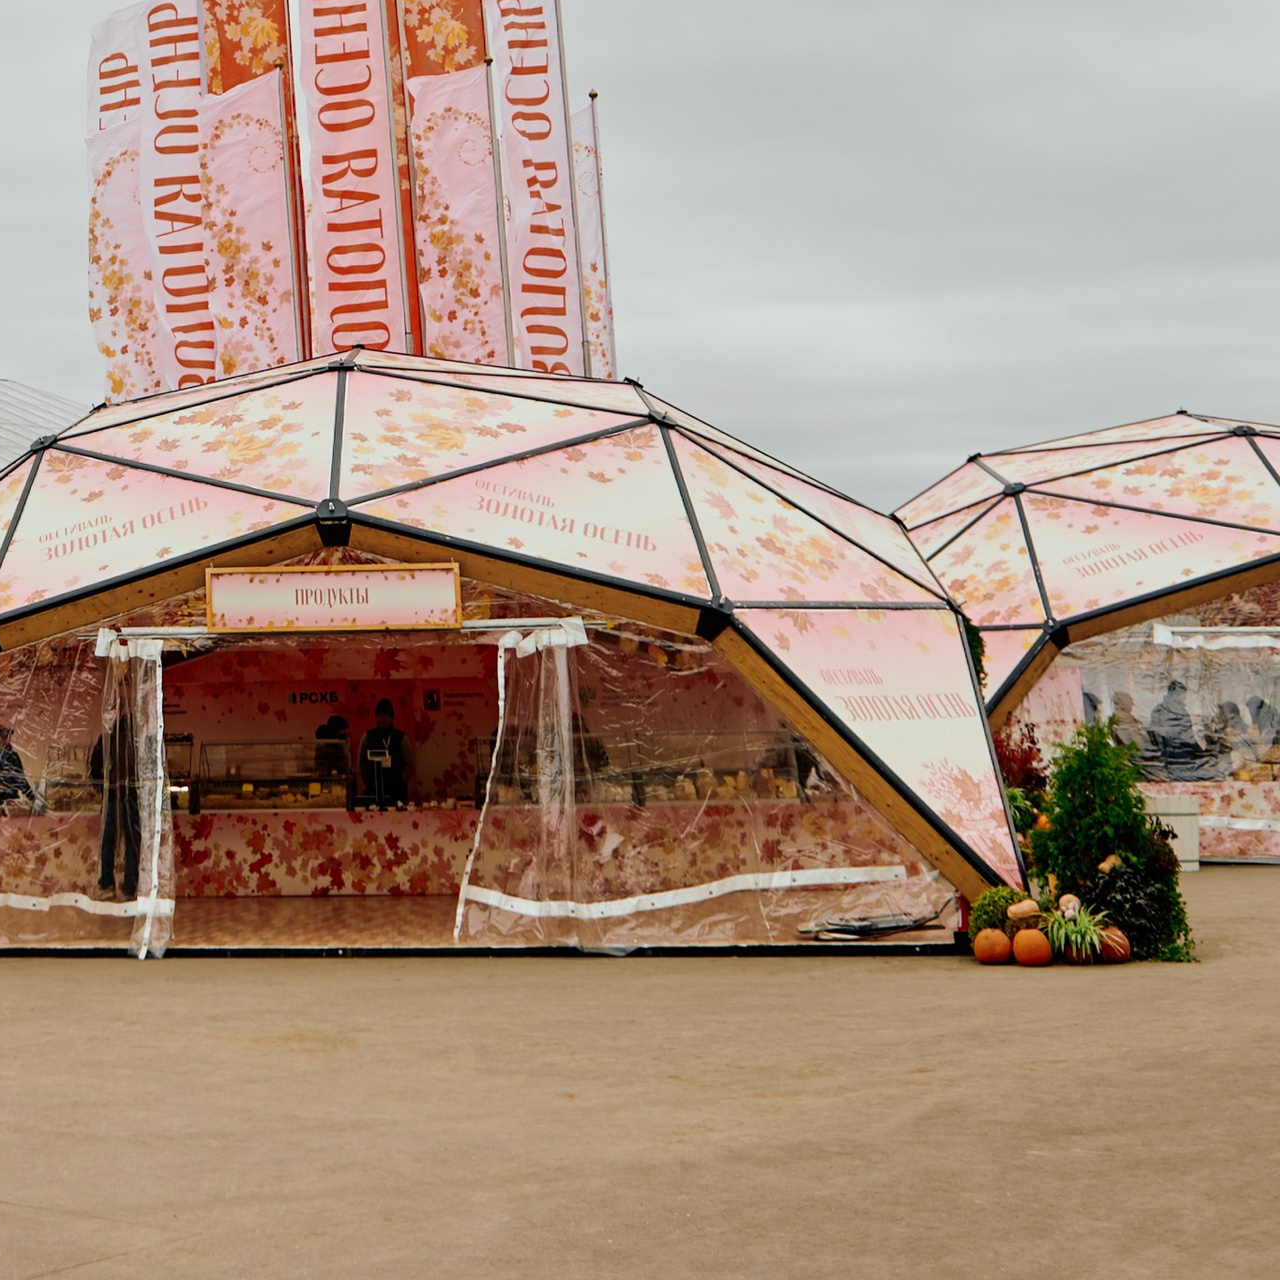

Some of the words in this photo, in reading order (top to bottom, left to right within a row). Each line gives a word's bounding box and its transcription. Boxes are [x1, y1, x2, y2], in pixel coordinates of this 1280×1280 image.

[474, 478, 555, 508] ФЕСТИВАЛЬ
[38, 514, 112, 544] ФЕСТИВАЛЬ
[39, 520, 135, 564] ЗОЛОТАЯ
[141, 496, 208, 530] ОСЕНЬ
[470, 493, 575, 534] ЗОЛОТАЯ
[583, 522, 658, 552] ОСЕНЬ
[295, 587, 369, 609] ПРОДУКТЫ
[299, 691, 339, 704] РСХБ
[835, 694, 922, 722] ЗОЛОТАЯ
[915, 692, 977, 719] ОСЕНЬ
